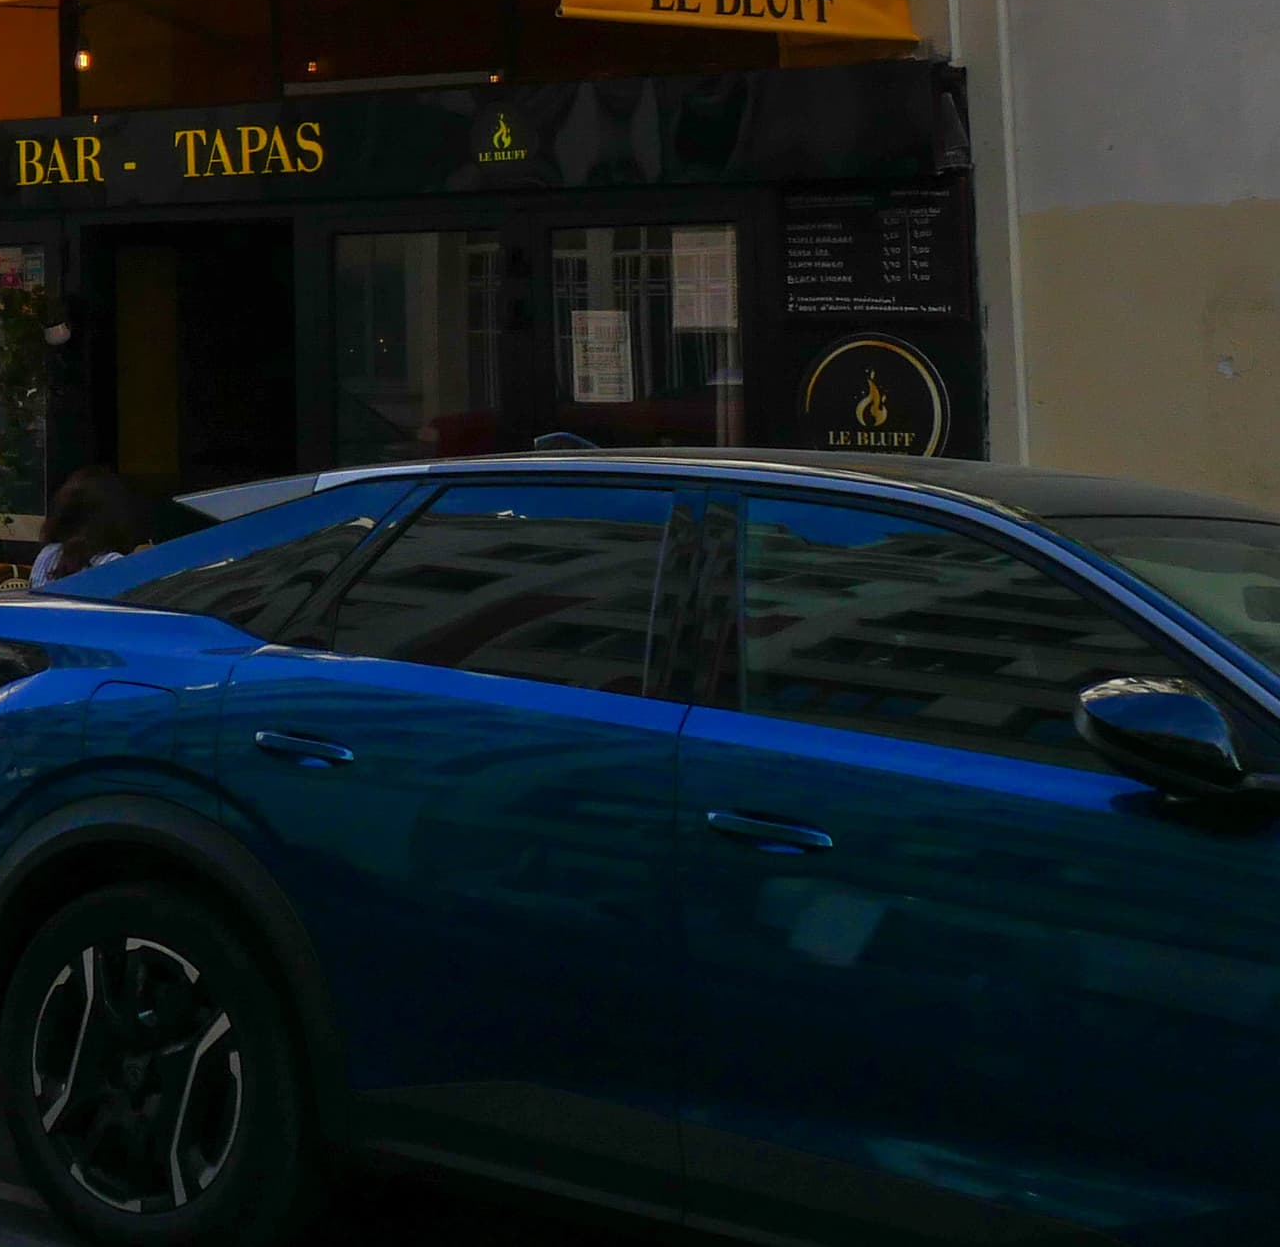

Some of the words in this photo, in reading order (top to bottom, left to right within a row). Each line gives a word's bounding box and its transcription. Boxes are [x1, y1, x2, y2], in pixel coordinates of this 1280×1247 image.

[16, 136, 104, 186] BAR
[175, 122, 324, 178] TAPAS
[479, 152, 493, 162] LE
[494, 149, 528, 161] BLUFF
[828, 430, 851, 446] LE
[857, 430, 916, 447] BLUFF
